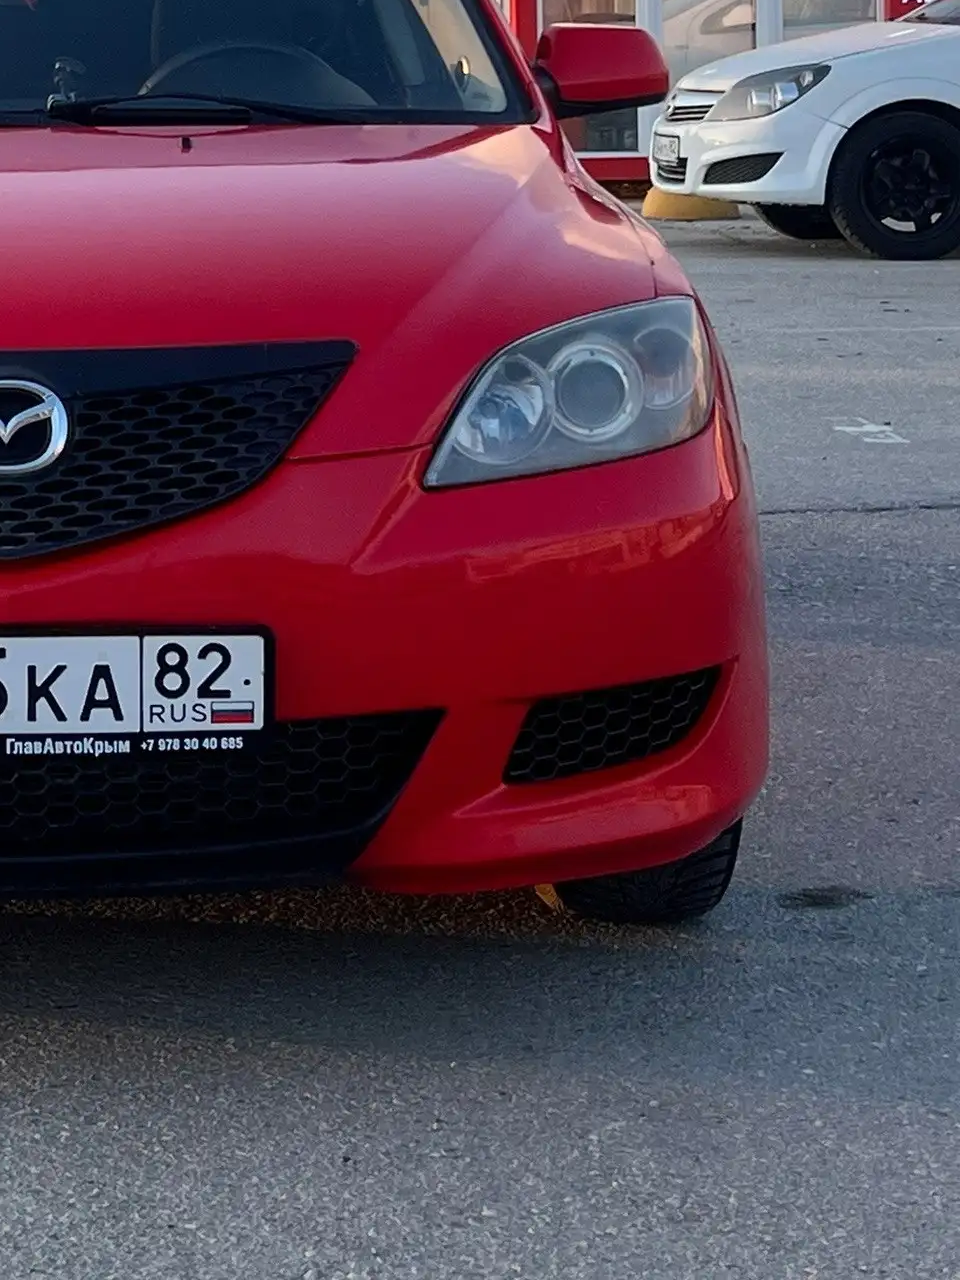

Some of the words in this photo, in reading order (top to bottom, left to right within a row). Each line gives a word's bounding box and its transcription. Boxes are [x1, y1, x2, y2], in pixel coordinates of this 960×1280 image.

[154, 642, 232, 699] 82
[149, 703, 207, 723] RUS
[5, 737, 131, 756] ГлавАвтоКрым
[140, 740, 154, 751] +7
[158, 738, 180, 751] 978
[183, 738, 198, 751] 30
[201, 738, 218, 750] 40
[220, 736, 244, 750] 685
